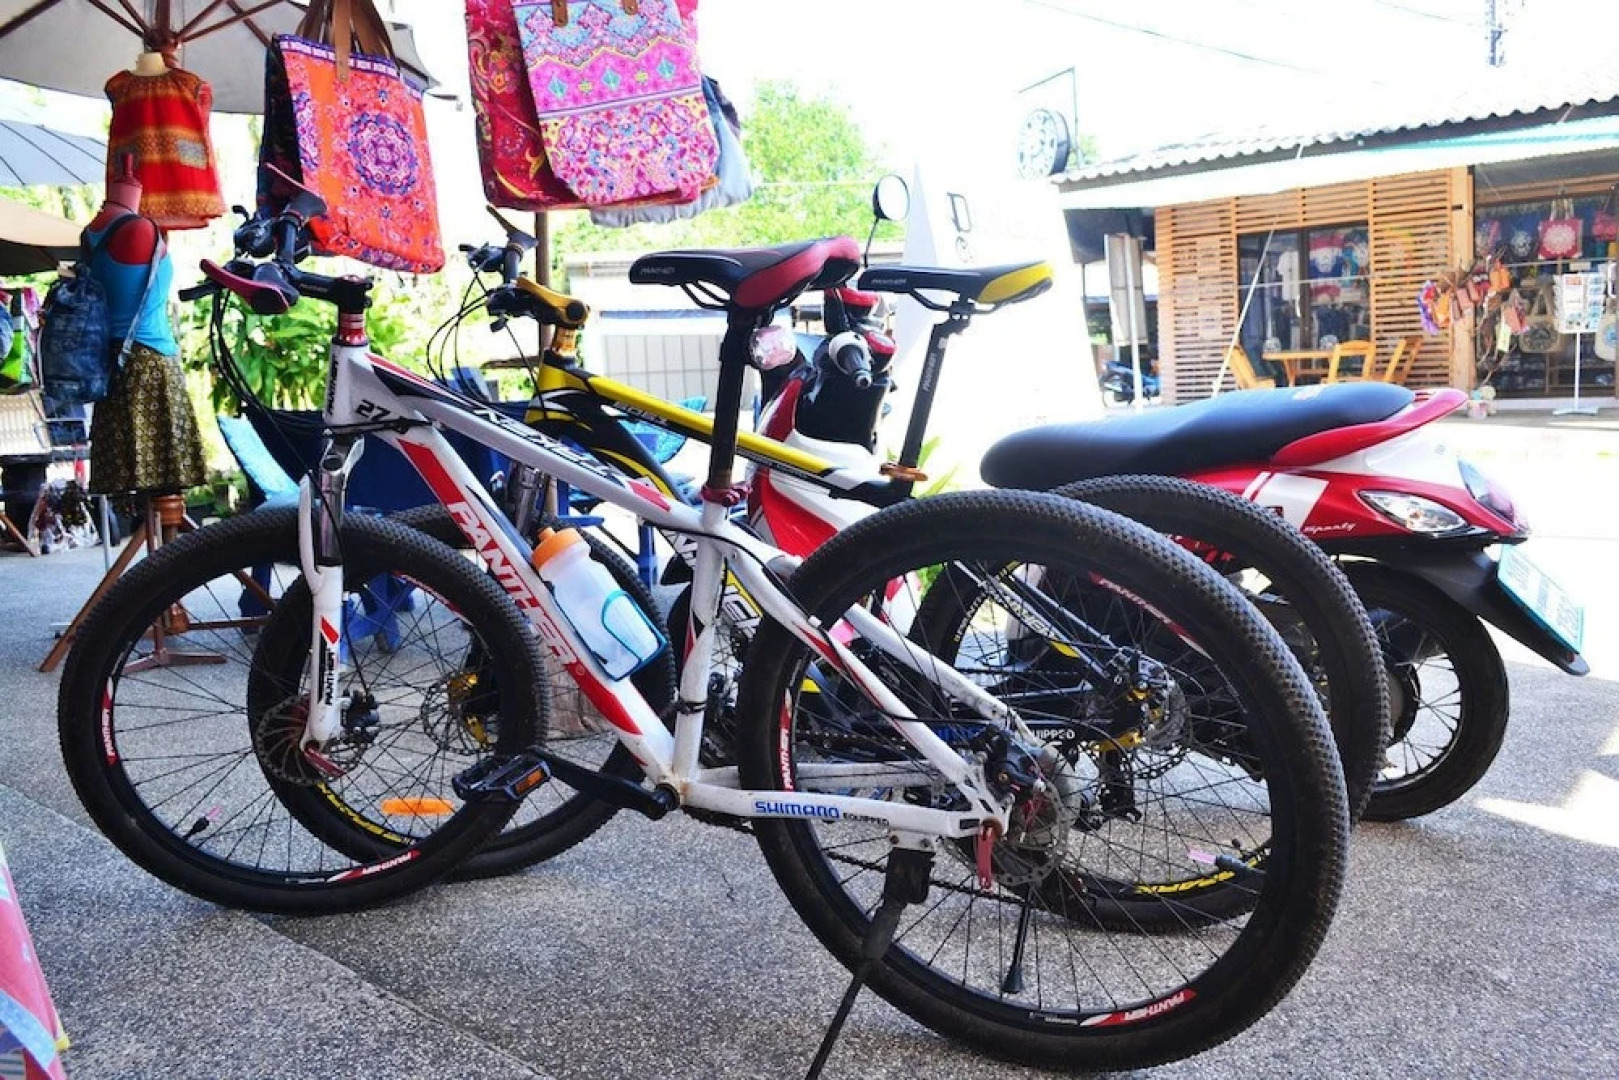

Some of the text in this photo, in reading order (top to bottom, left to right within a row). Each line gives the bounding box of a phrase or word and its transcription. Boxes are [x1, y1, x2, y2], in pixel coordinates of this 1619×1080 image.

[447, 502, 578, 666] PANTHER
[755, 800, 890, 827] SHIMANO EQUIPPED
[1123, 991, 1186, 1021] PANTHER
